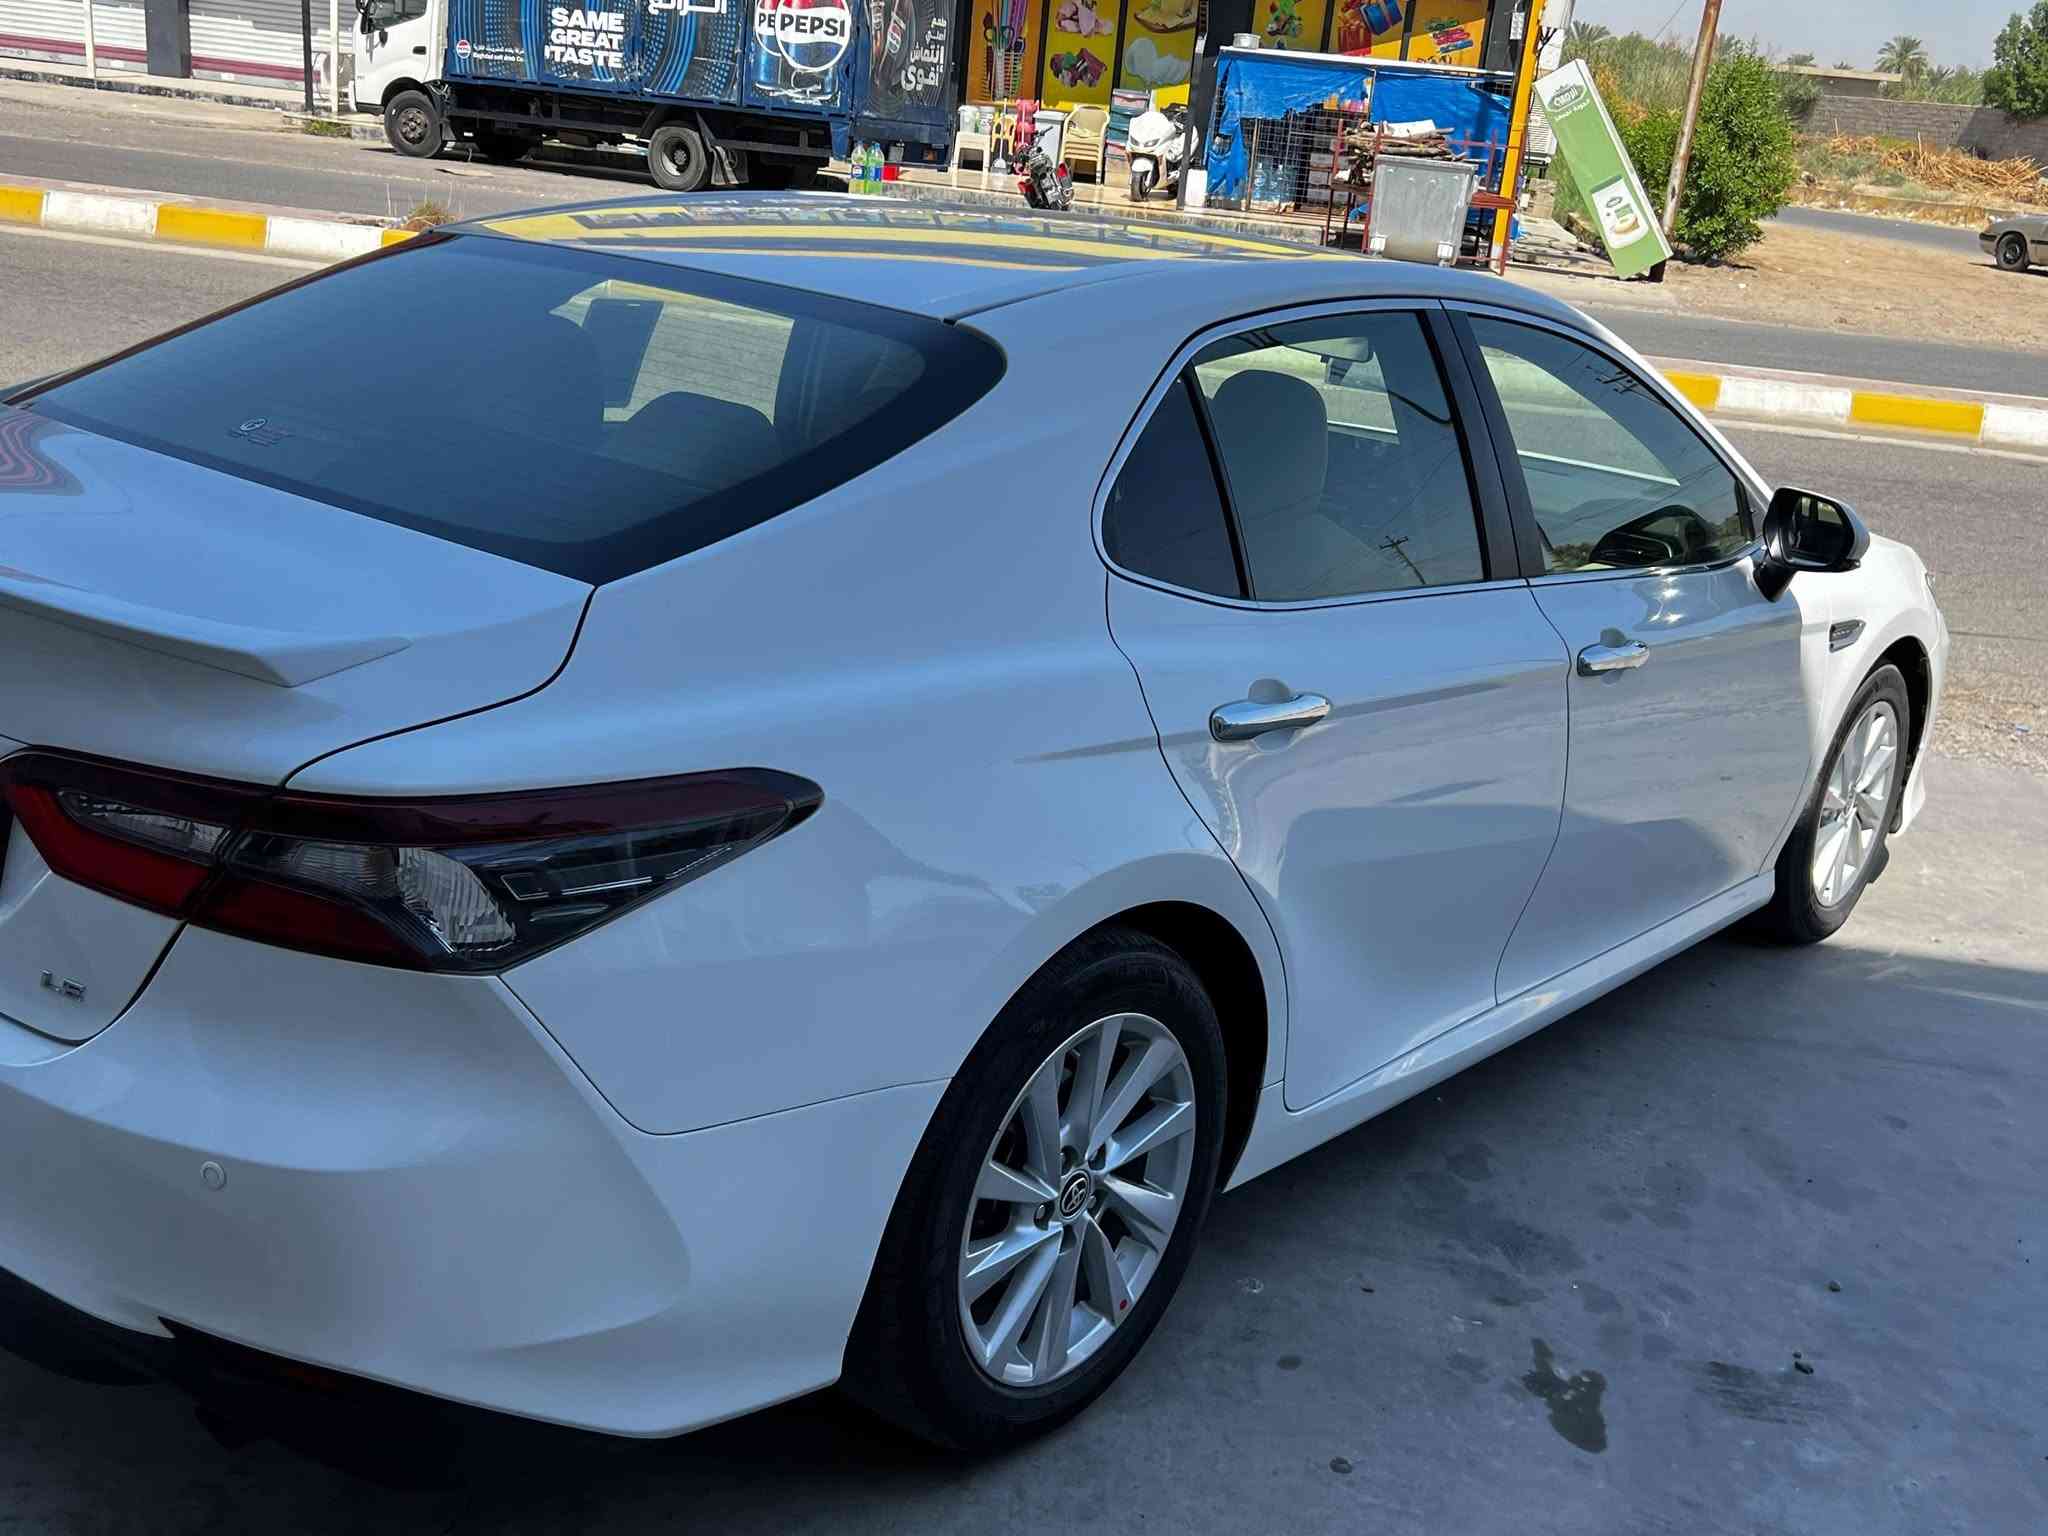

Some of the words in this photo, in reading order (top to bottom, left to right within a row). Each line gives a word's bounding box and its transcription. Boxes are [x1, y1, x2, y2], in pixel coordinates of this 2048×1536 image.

[551, 7, 625, 32] SAME
[780, 13, 846, 37] PEPSI
[550, 28, 624, 50] GREAT
[550, 45, 625, 69] TASTE
